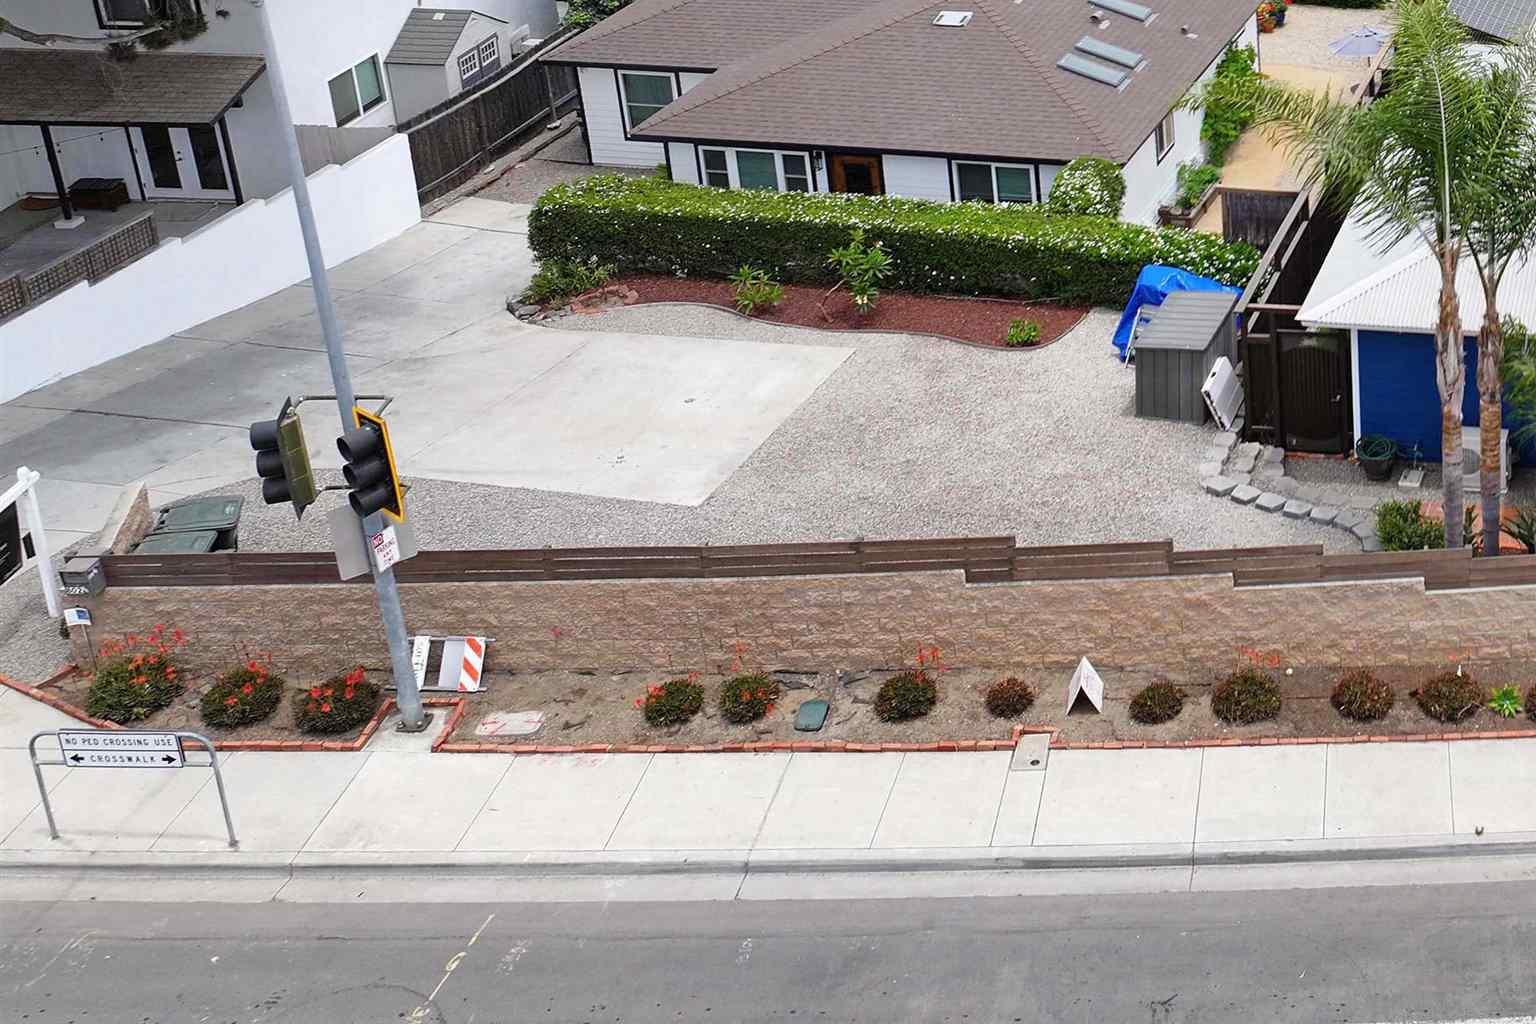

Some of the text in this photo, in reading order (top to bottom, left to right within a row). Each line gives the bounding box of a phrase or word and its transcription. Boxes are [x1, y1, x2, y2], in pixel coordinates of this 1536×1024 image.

[65, 737, 173, 746] NO PED CROSSING USE
[90, 755, 157, 763] CROSSWALK
